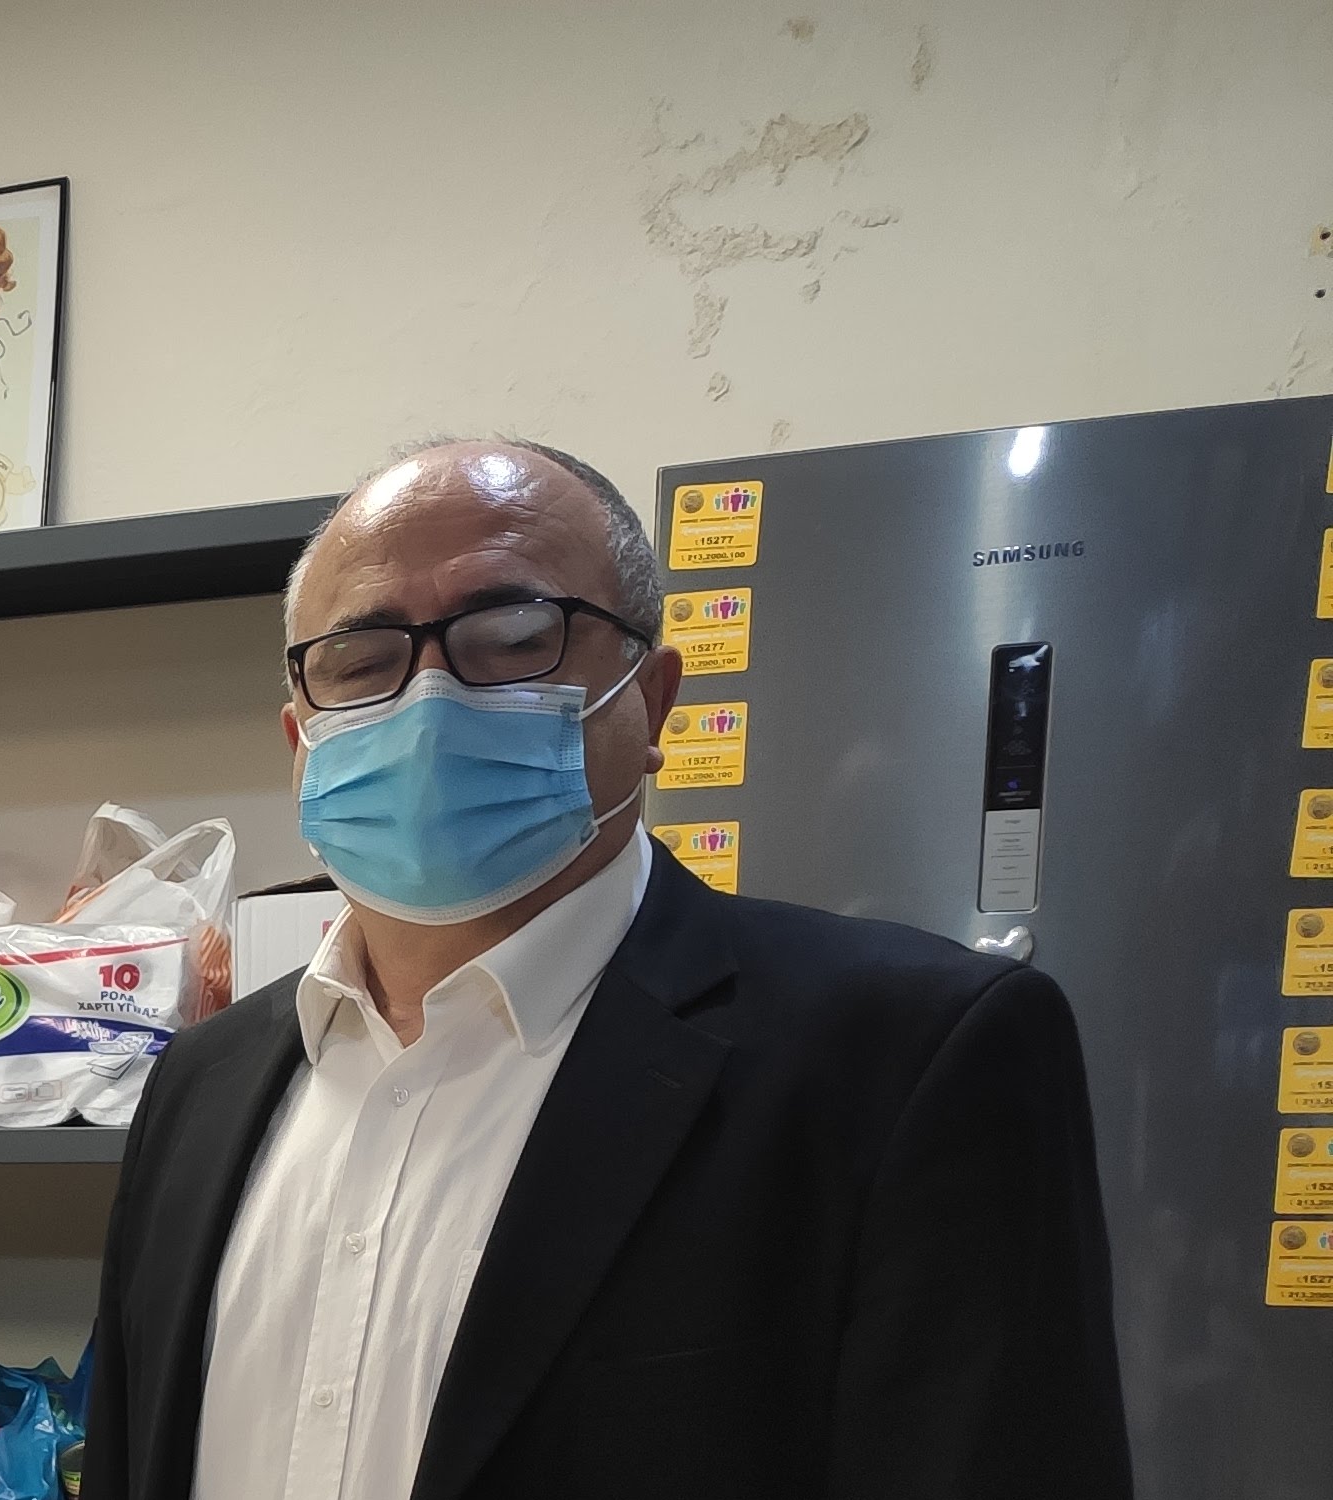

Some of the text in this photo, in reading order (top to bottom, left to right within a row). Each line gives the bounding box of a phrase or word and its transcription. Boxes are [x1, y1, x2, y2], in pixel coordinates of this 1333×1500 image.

[701, 535, 735, 546] 15277
[972, 541, 1085, 567] SAMSUNG
[691, 641, 725, 653] 15277
[685, 657, 737, 668] 13.2000.100
[687, 755, 721, 766] 15277
[99, 963, 141, 991] 10
[77, 1002, 115, 1012] ΧΑΡΤΙ
[1311, 1182, 1333, 1191] 152
[1302, 1275, 1333, 1284] 1527
